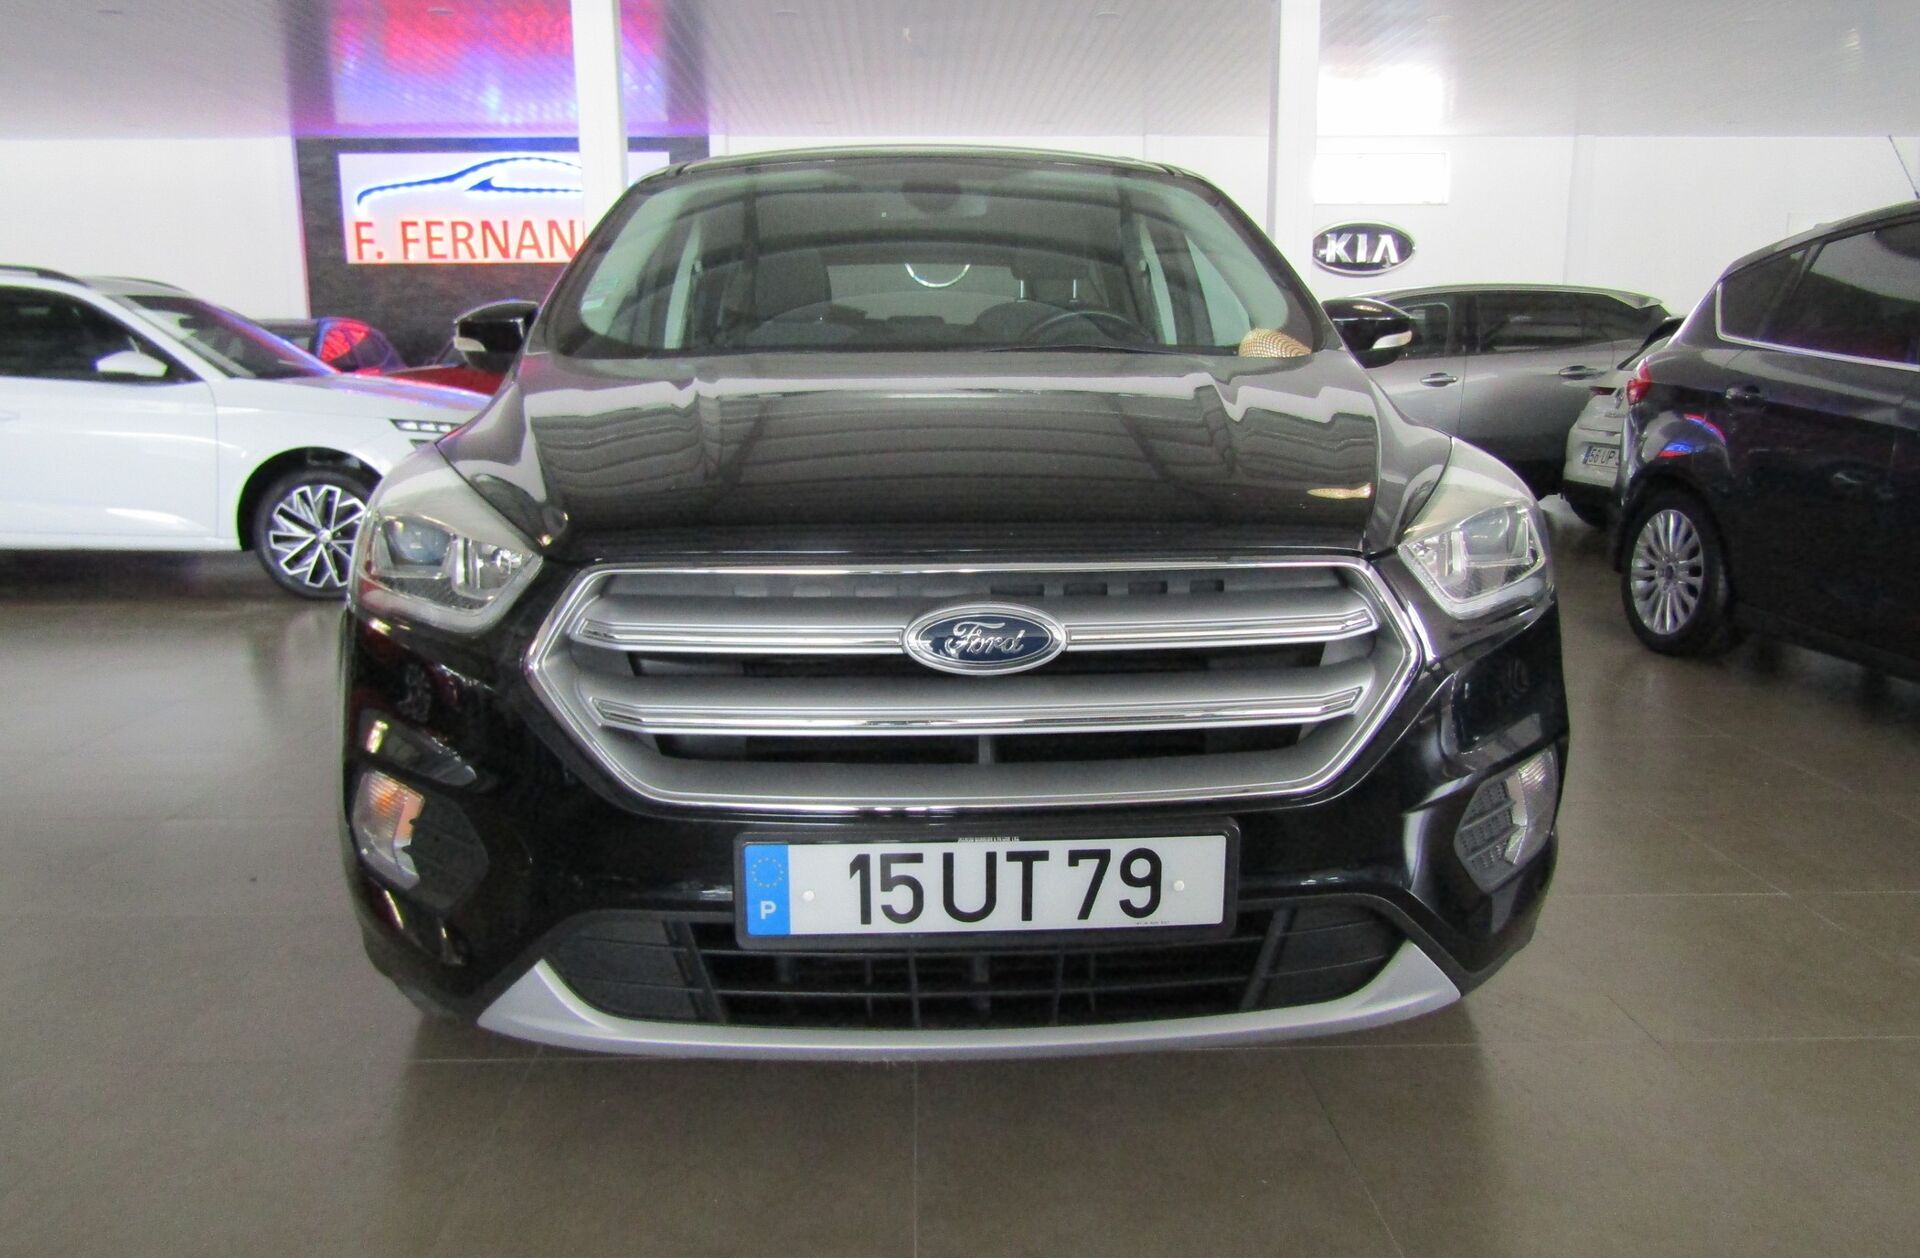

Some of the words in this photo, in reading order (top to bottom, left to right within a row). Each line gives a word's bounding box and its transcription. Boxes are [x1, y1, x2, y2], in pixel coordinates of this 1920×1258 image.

[354, 221, 383, 260] F.
[401, 220, 585, 260] FERNAN
[1325, 233, 1399, 263] KIA
[945, 621, 1026, 654] Ford
[760, 900, 777, 919] P
